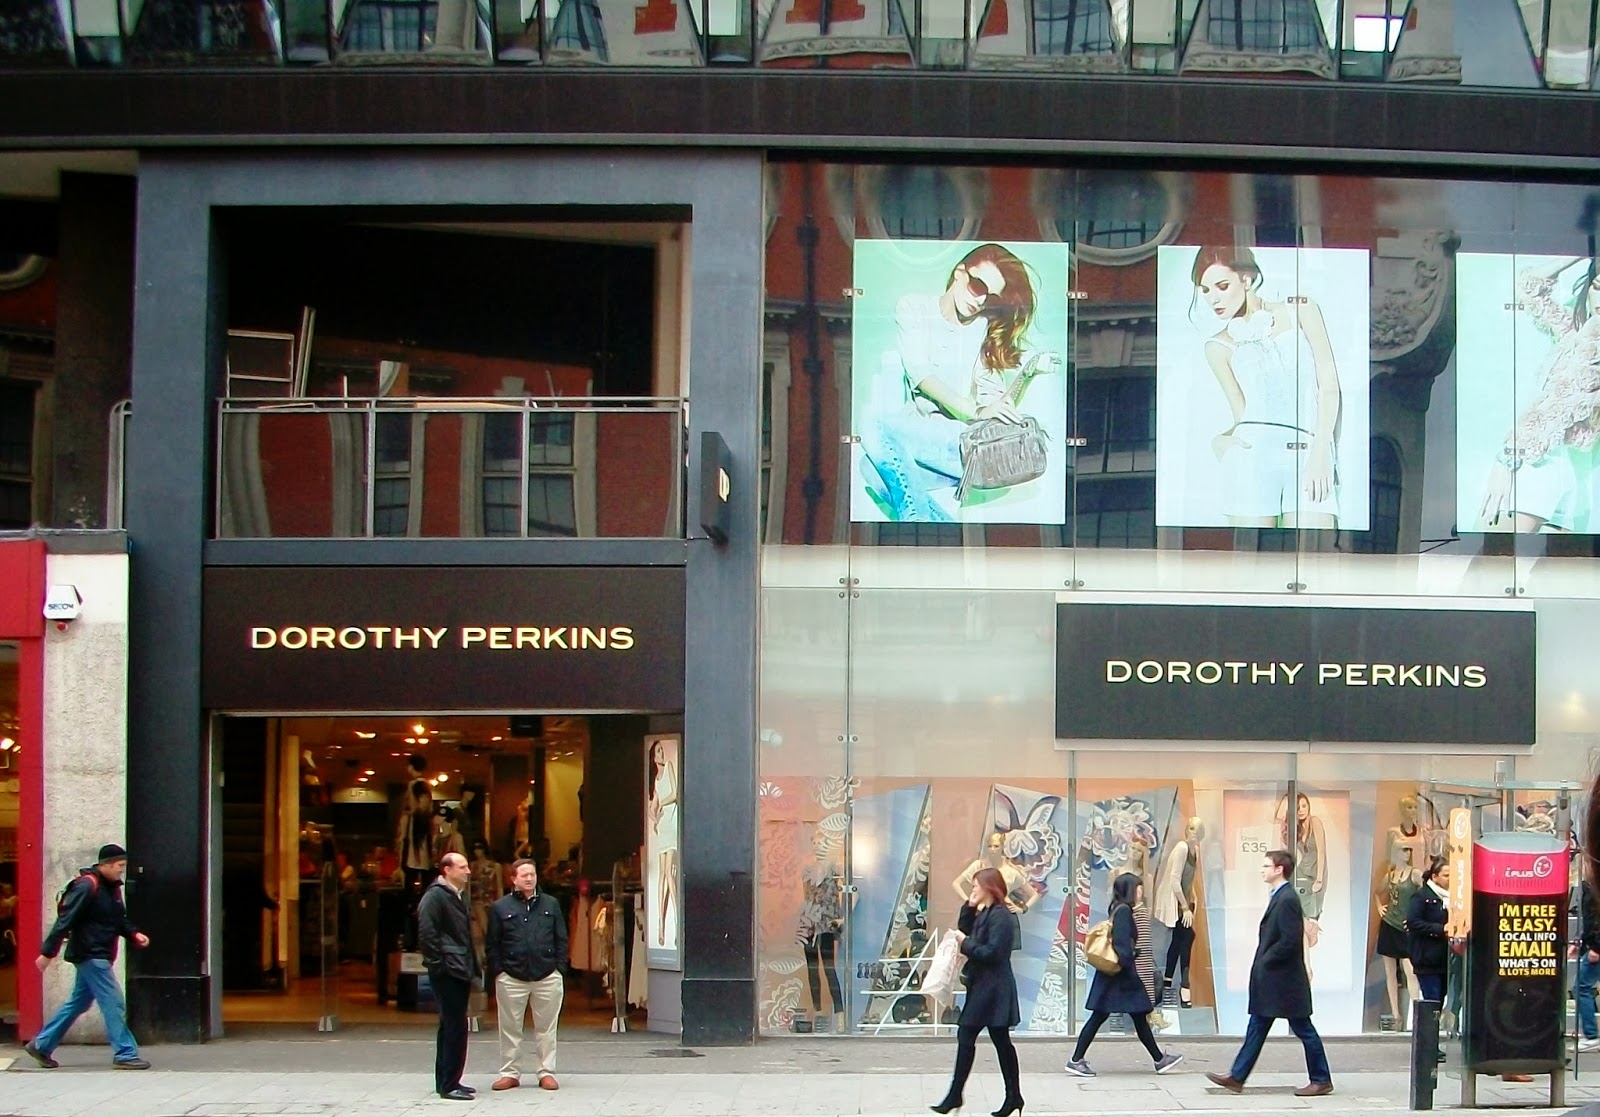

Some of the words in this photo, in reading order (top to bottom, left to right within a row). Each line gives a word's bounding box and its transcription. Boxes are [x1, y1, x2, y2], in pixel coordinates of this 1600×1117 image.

[250, 626, 448, 650] DOROTHY
[461, 626, 635, 650] PERKINS
[1106, 660, 1304, 685] DOROTHY
[1318, 662, 1488, 688] PERKINS
[1241, 842, 1267, 853] £35
[1499, 902, 1520, 917] I'M
[1522, 904, 1557, 917] FREE
[1498, 918, 1511, 932] &
[1513, 918, 1557, 932] EASY.
[1499, 932, 1533, 941] LOCAL
[1533, 932, 1557, 941] INFO
[1499, 941, 1556, 957] EMAIL
[1498, 957, 1540, 968] WHAT'S
[1540, 958, 1557, 968] ON
[1498, 968, 1506, 976] &
[1507, 968, 1530, 976] LOTS
[1530, 968, 1557, 976] MORE
